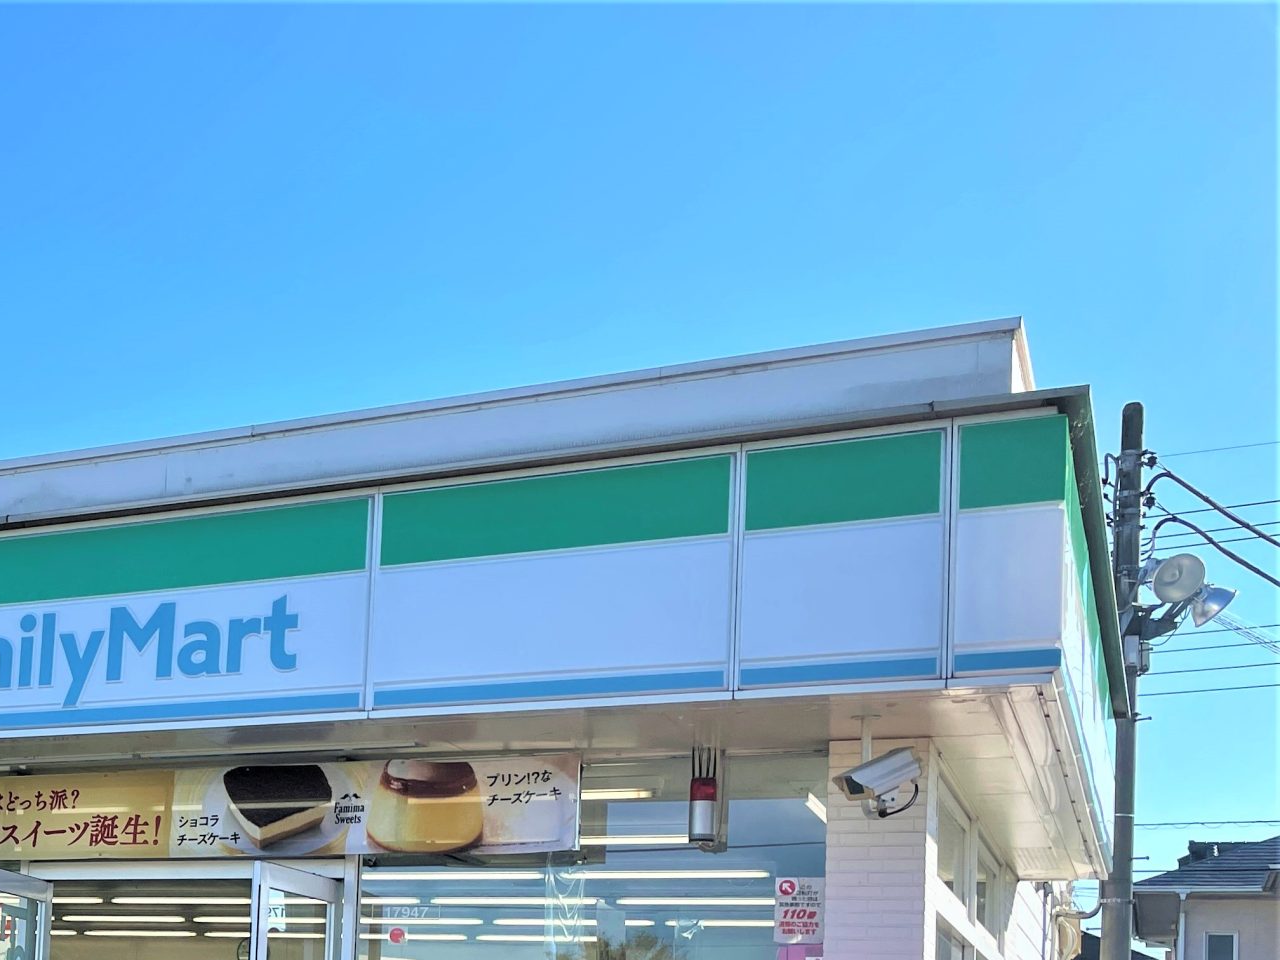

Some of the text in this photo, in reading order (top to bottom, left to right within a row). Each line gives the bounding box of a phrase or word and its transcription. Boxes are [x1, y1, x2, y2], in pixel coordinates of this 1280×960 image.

[486, 770, 552, 787] プリン!?な
[486, 787, 562, 806] チーズケーキ
[333, 801, 366, 814] Famima
[178, 814, 220, 829] ショコラ
[334, 813, 362, 825] Sweets
[177, 831, 241, 846] チーズケーキ
[385, 907, 429, 918] 17947
